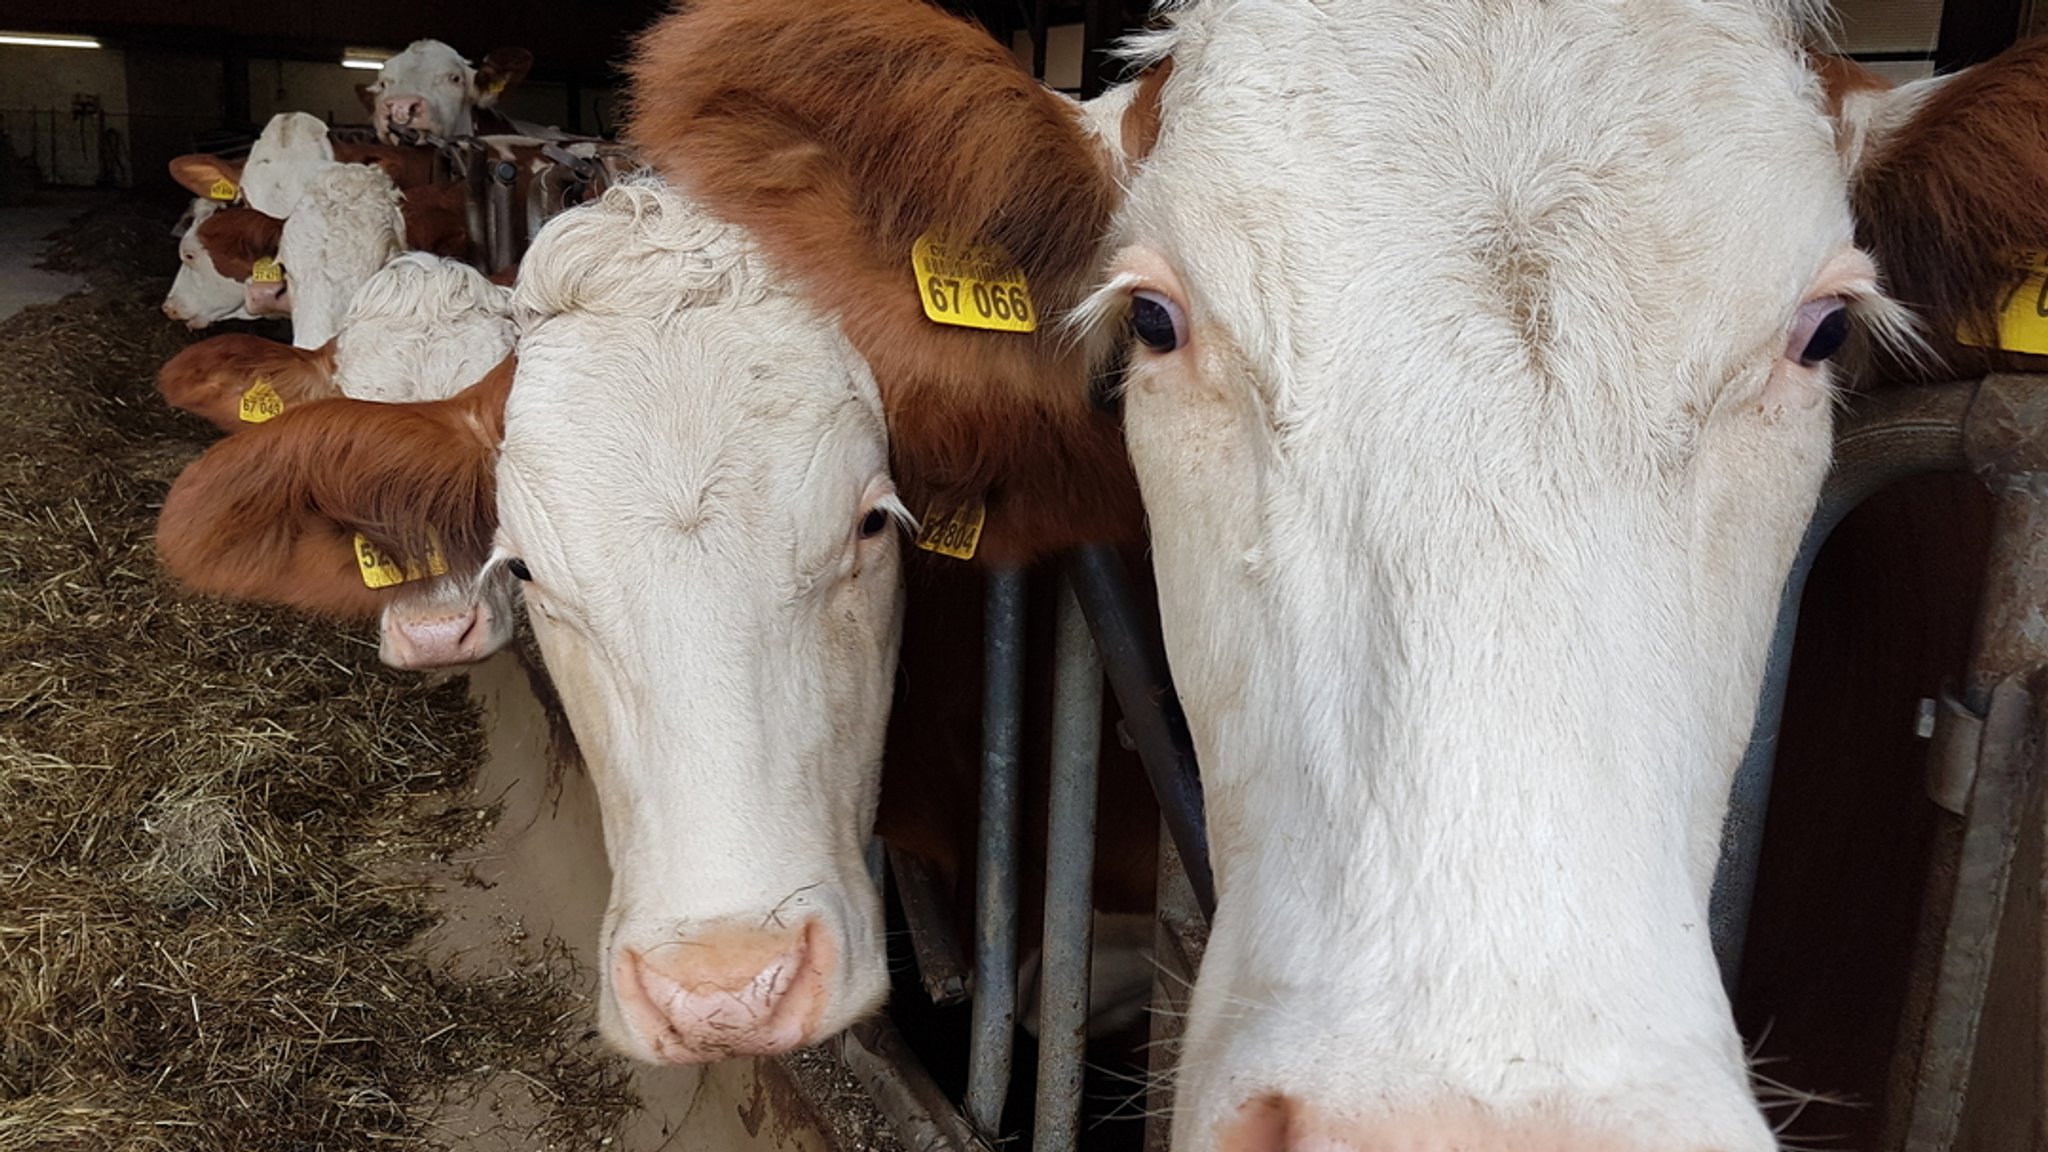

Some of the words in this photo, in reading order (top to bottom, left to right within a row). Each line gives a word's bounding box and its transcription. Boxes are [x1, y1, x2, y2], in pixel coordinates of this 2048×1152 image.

[927, 275, 961, 315] 67
[971, 281, 1029, 323] 066
[243, 398, 258, 413] 67
[943, 522, 978, 555] 804
